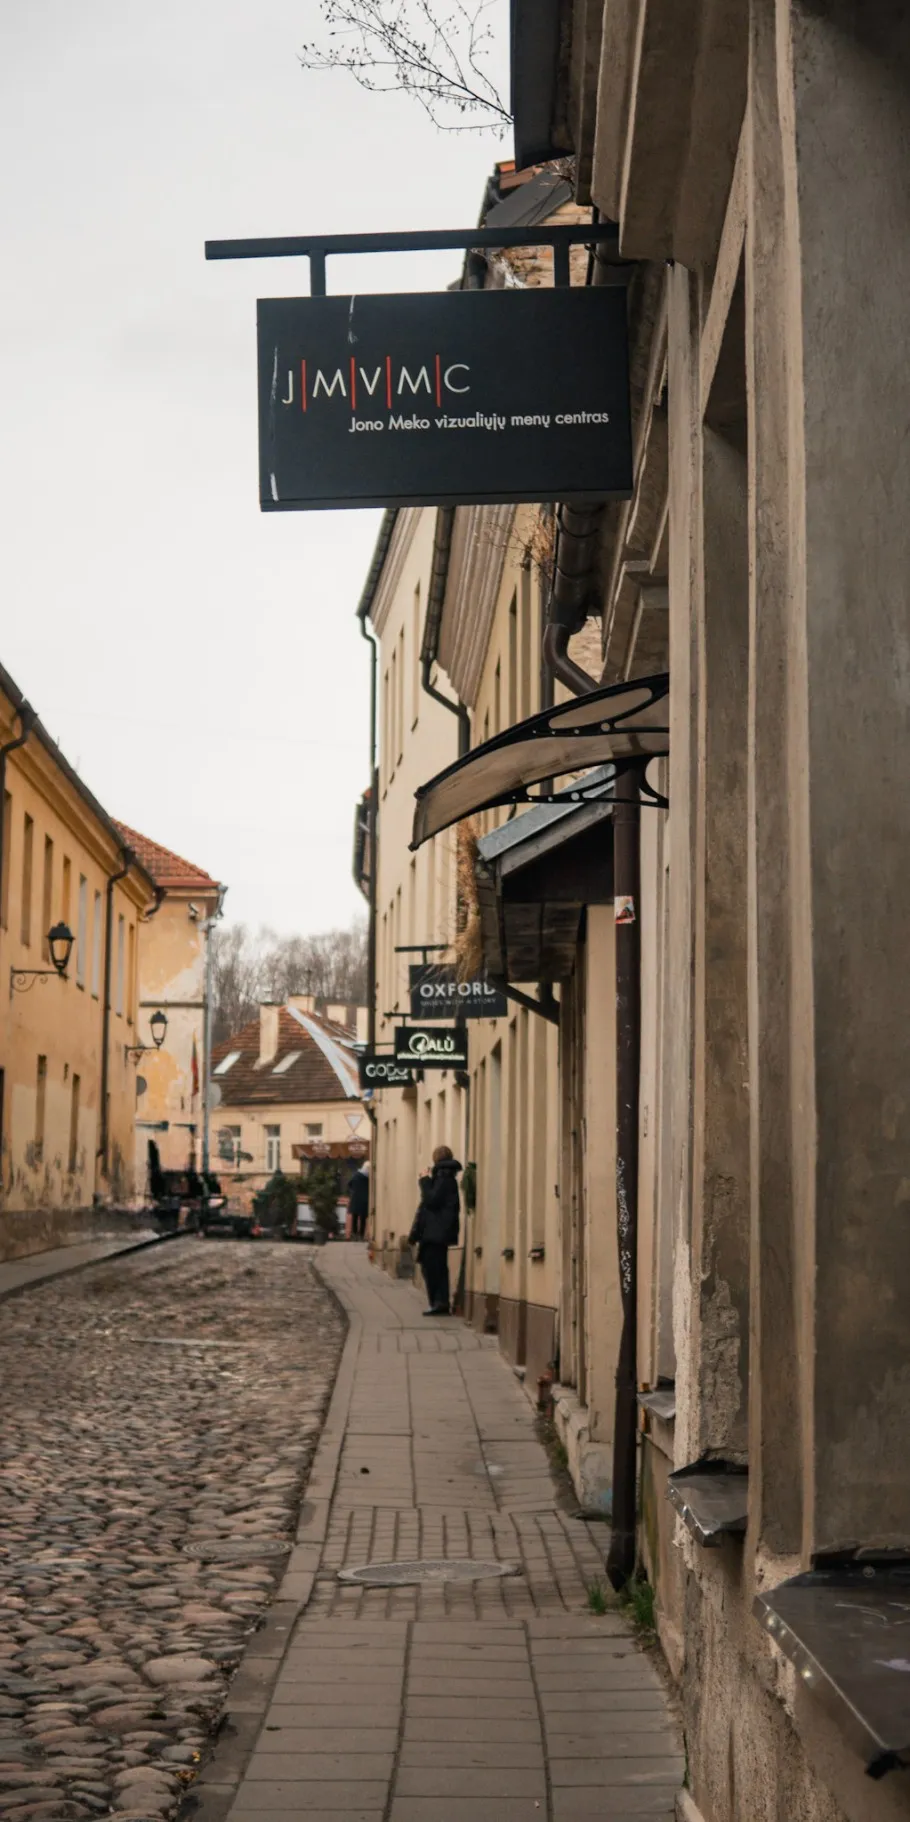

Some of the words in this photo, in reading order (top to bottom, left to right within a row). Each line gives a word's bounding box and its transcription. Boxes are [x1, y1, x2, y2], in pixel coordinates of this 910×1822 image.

[349, 416, 384, 432] Jono
[388, 414, 430, 430] Meko
[435, 412, 506, 431] vizualiųjų
[511, 412, 551, 429] menų
[555, 411, 609, 425] centras
